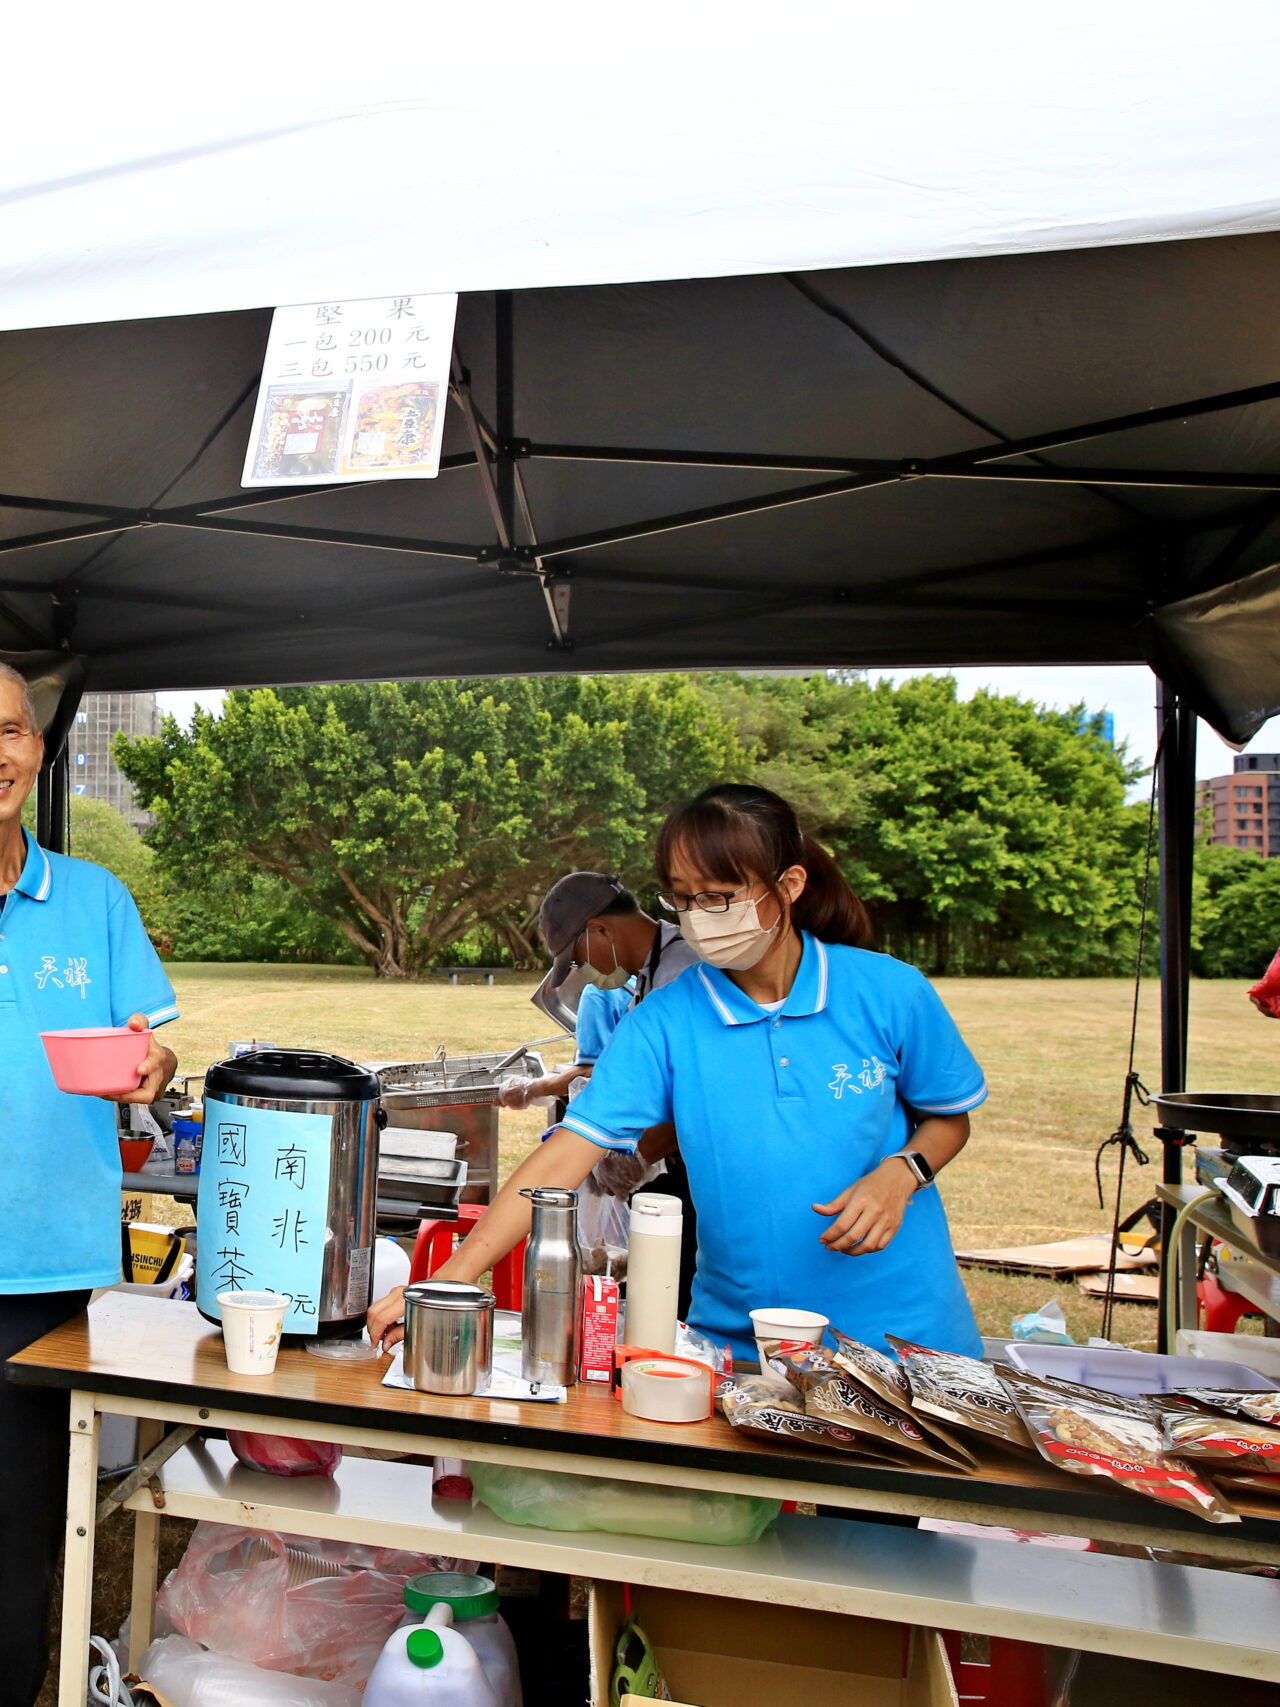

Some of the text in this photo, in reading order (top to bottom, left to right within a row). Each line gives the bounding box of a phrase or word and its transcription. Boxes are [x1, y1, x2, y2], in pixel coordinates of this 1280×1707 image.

[77, 754, 85, 765] 9
[33, 955, 92, 1000] 天祥
[827, 1055, 888, 1100] 天祥
[210, 1122, 255, 1292] 國寶茶
[270, 1142, 310, 1253] 南非
[758, 1410, 829, 1435] 土豆康
[837, 1379, 900, 1428] 土豆康
